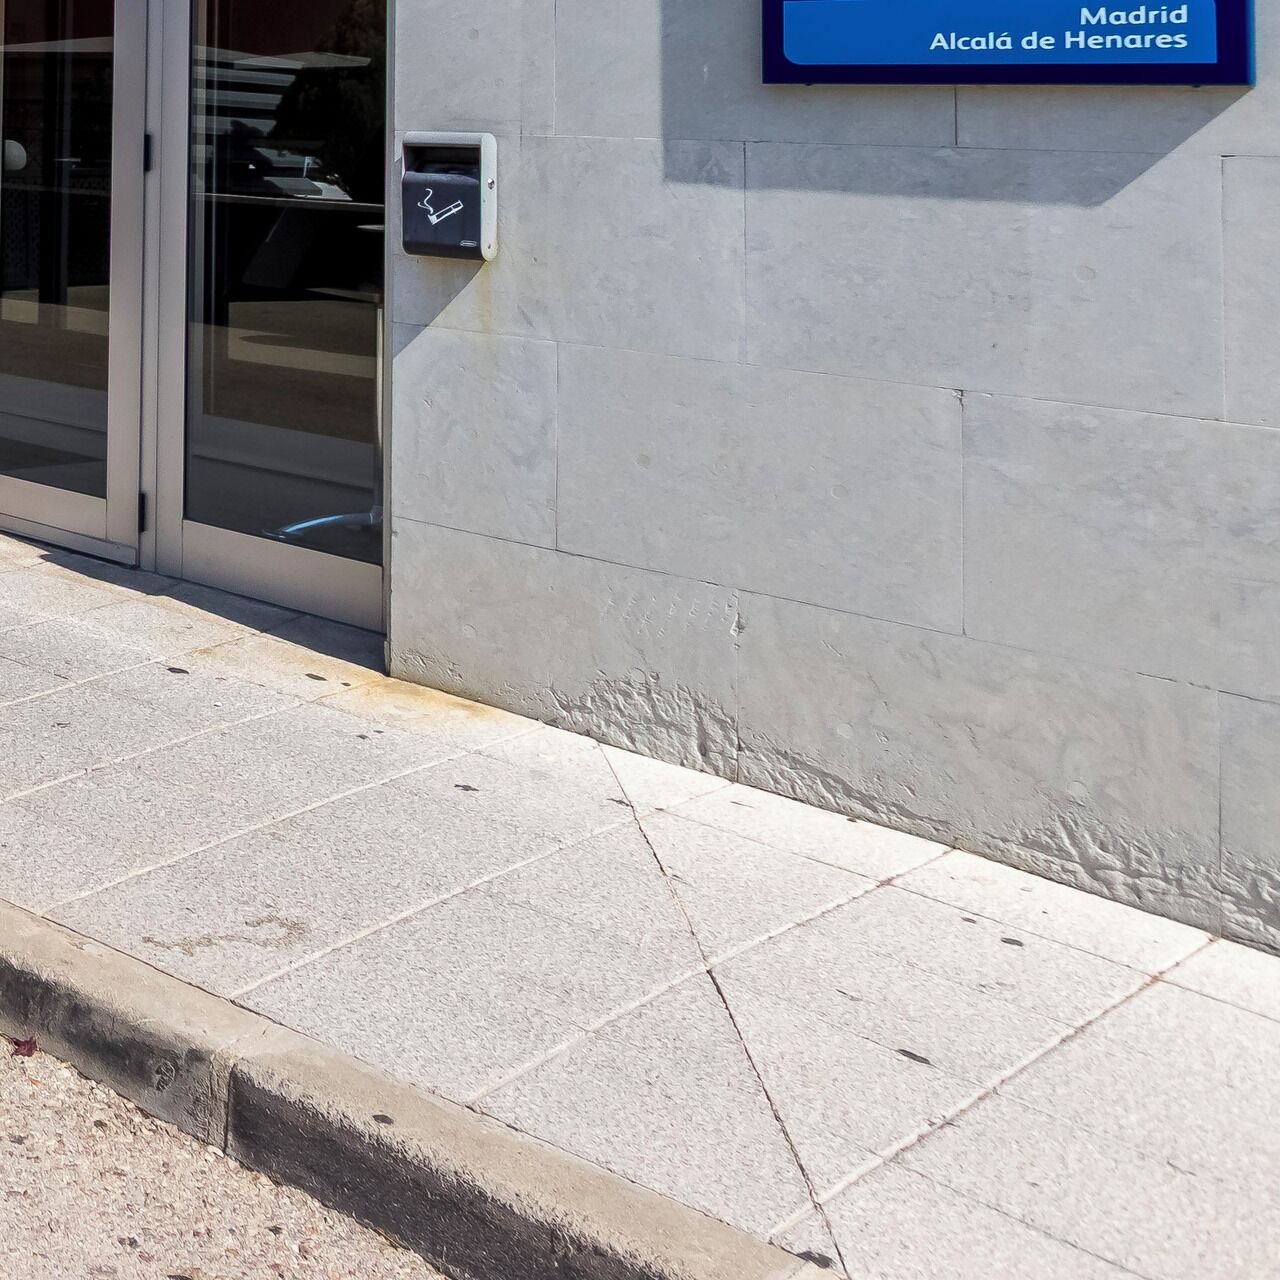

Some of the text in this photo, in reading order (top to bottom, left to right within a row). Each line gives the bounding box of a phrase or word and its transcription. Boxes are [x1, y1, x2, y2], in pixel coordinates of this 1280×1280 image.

[1080, 5, 1188, 25] Madrid
[929, 30, 1188, 50] Alcalá de Henares
